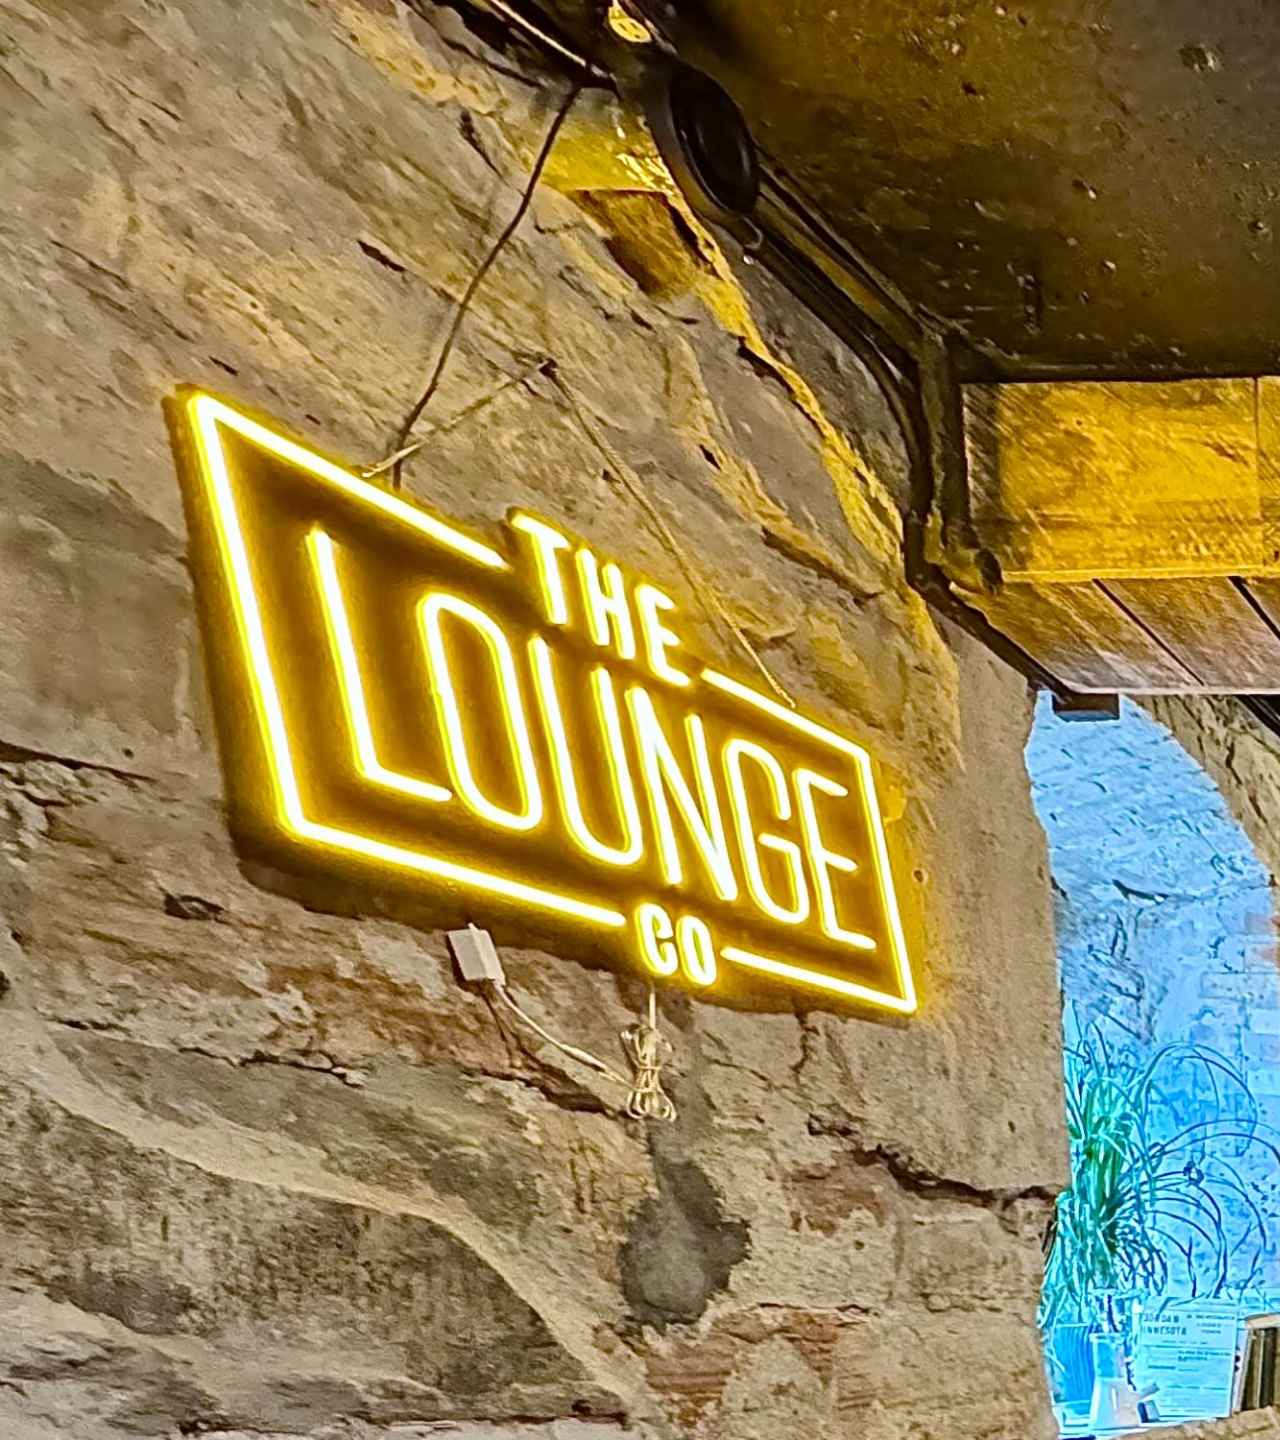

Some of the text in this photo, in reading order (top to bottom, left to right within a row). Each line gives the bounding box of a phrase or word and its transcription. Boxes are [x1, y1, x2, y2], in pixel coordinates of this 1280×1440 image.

[511, 511, 691, 686] THE
[305, 526, 877, 950] LOUNGE
[634, 902, 719, 986] CO
